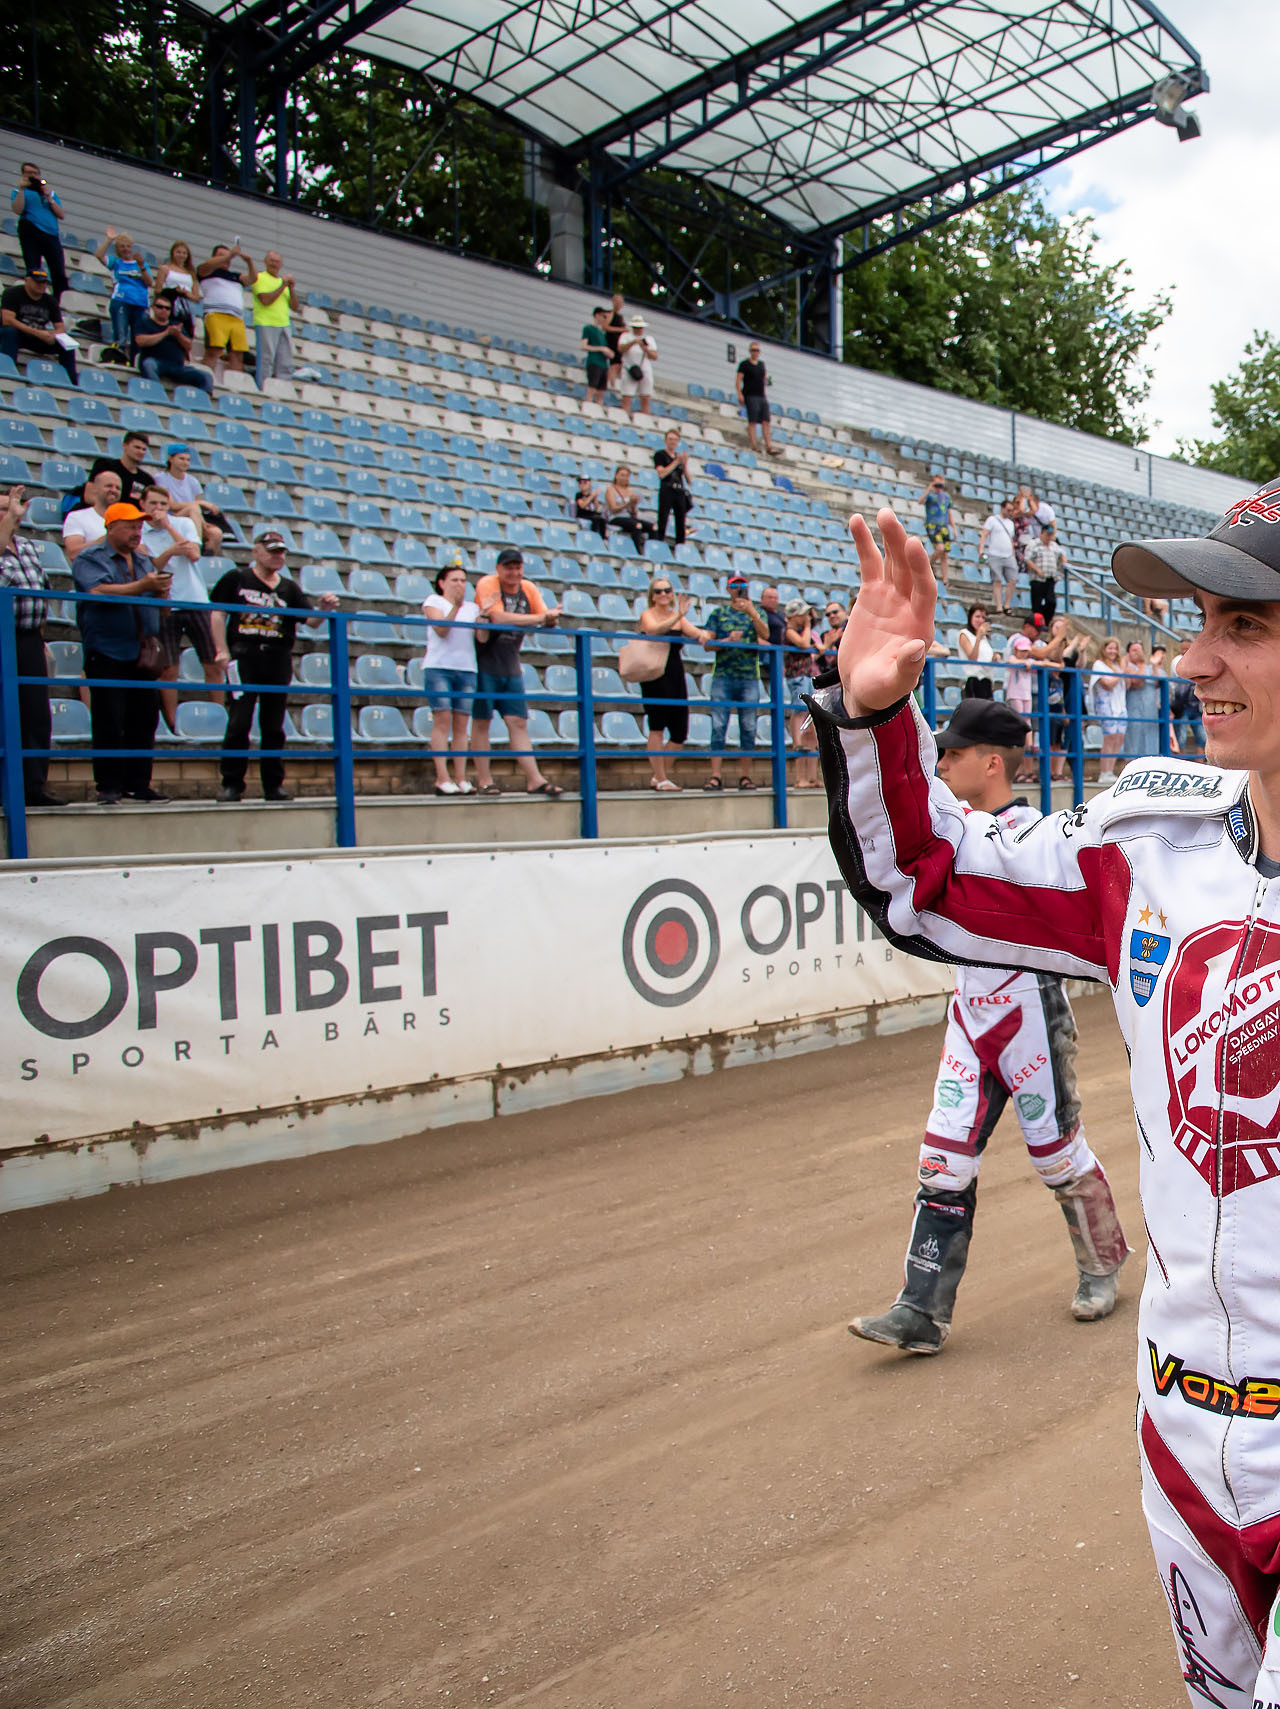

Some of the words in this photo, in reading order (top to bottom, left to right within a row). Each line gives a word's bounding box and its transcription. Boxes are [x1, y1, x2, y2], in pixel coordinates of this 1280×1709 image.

[1112, 770, 1222, 797] GORINA
[740, 879, 885, 955] OPTI
[16, 911, 449, 1040] OPTIBET
[742, 951, 864, 983] SPORTA
[20, 1029, 279, 1081] SPORTA
[325, 1008, 451, 1041] BĀRS
[1229, 1025, 1278, 1065] SPEEDWAY
[946, 1055, 977, 1083] SELS
[1014, 1053, 1047, 1084] SELS
